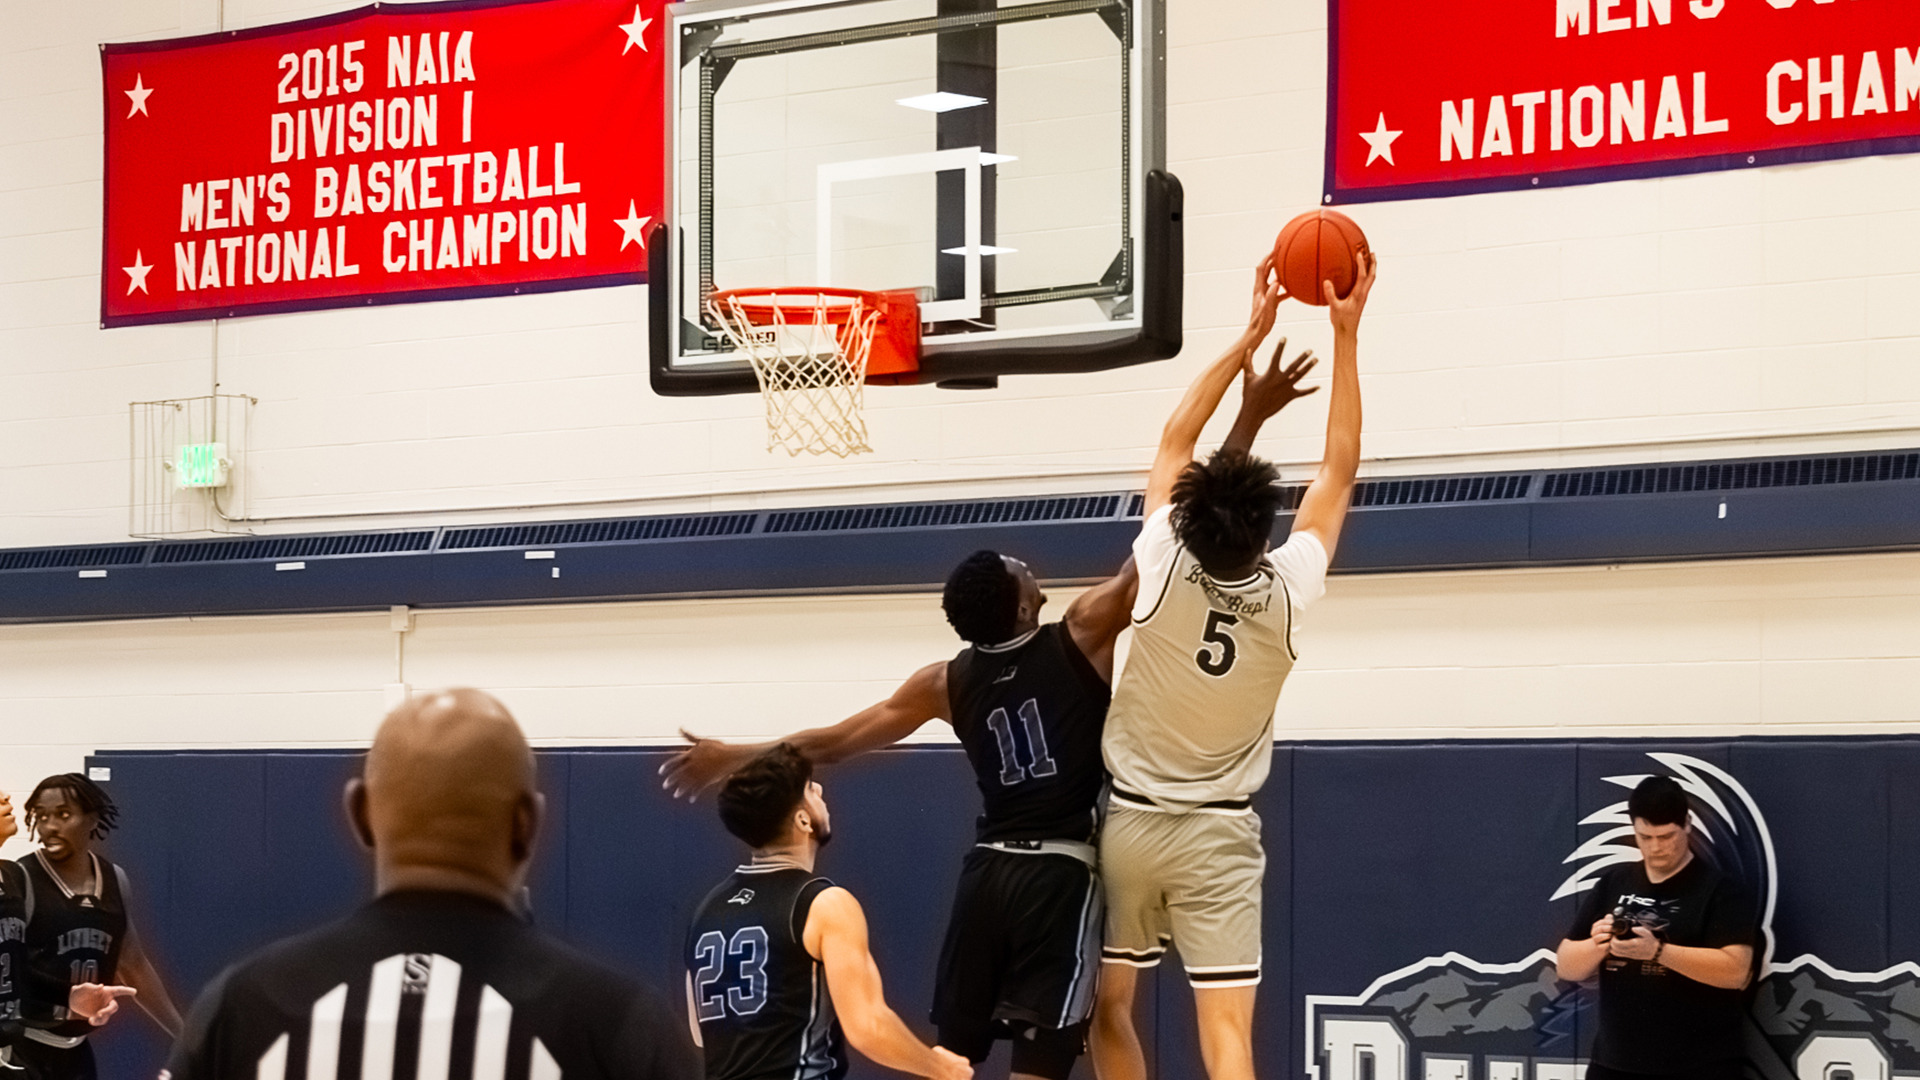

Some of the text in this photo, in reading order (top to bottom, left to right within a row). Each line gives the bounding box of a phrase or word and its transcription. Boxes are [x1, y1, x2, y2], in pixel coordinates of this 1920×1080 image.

[277, 31, 476, 104] 2015 NAIA
[1439, 46, 1920, 162] NATIONAL CHAM
[270, 90, 474, 164] DIVISION I
[180, 142, 581, 233] MEN'S BASKETBALL
[174, 202, 587, 292] NATIONAL CHAMPION
[1194, 607, 1242, 679] 5
[1226, 593, 1272, 618] Beep!
[987, 698, 1057, 786] 11
[695, 926, 768, 1022] 23
